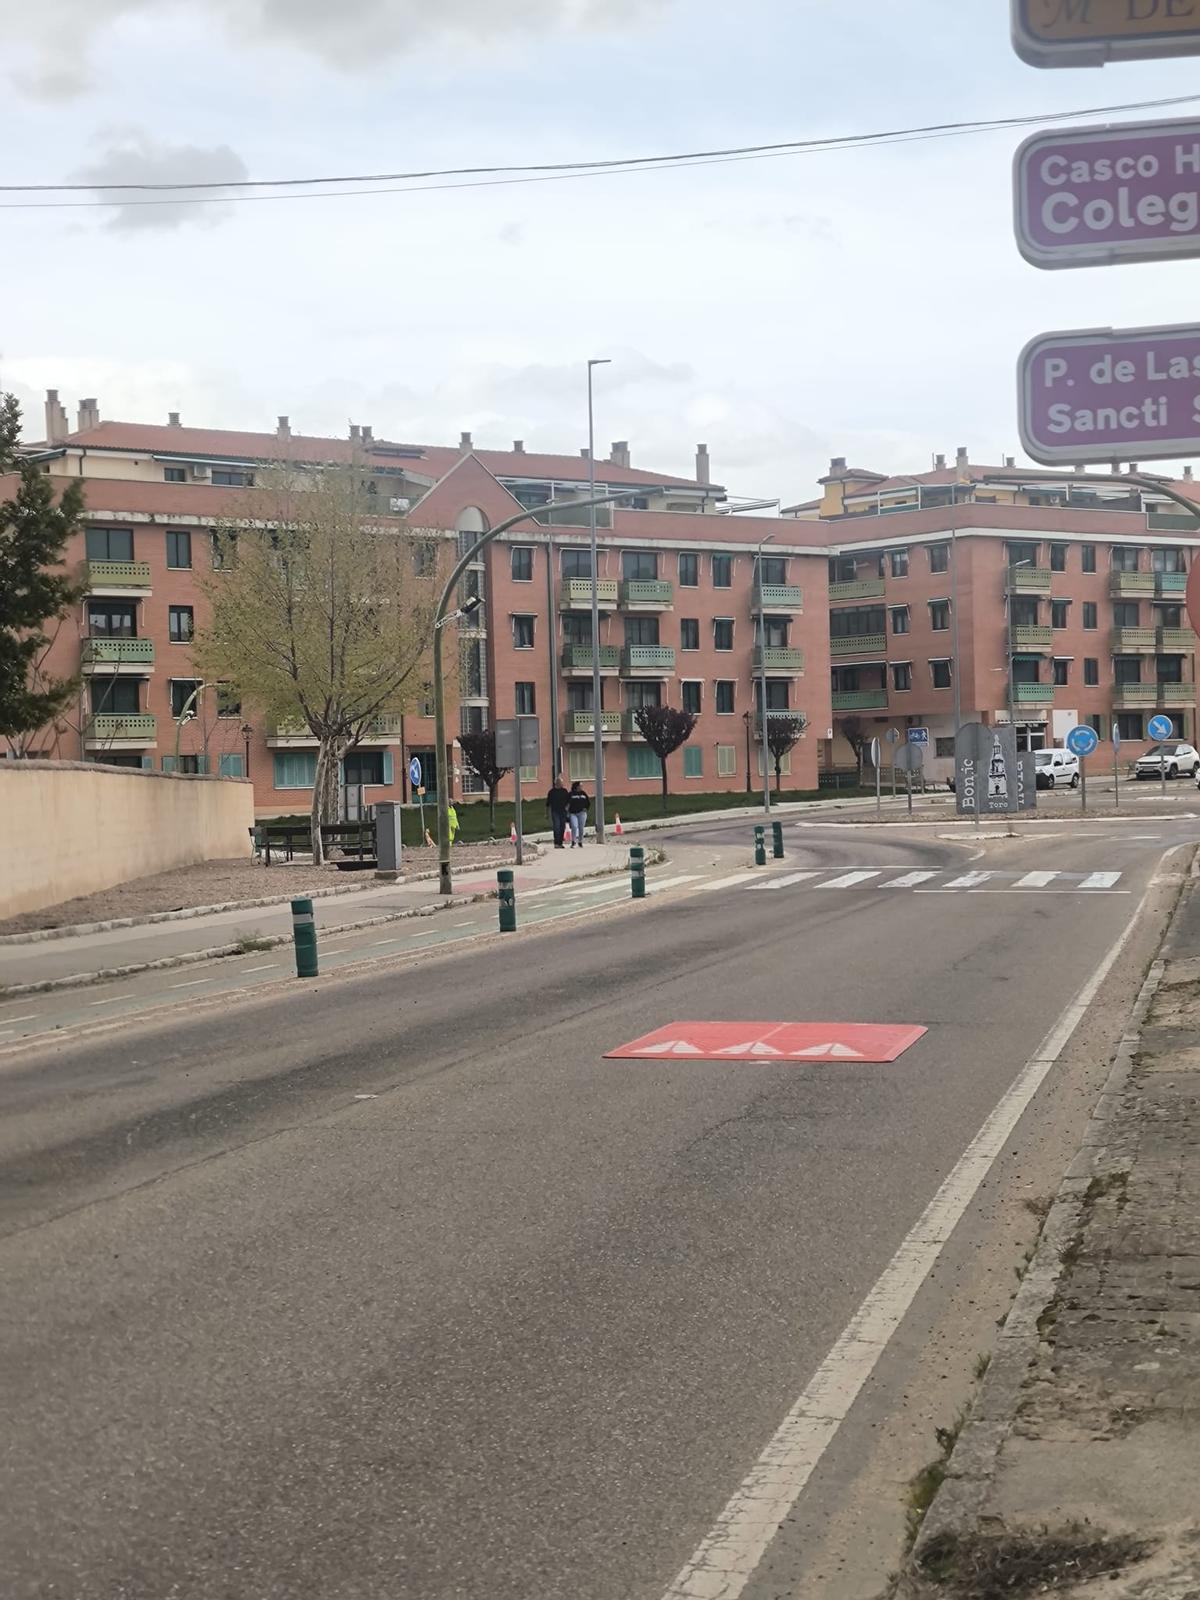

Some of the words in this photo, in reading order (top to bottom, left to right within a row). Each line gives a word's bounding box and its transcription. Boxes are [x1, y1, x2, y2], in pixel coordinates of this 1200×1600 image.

[1040, 154, 1159, 186] Casco
[1041, 186, 1200, 234] Coleg
[1044, 358, 1075, 387] P.
[1090, 354, 1136, 384] de
[1047, 396, 1168, 433] Sancti
